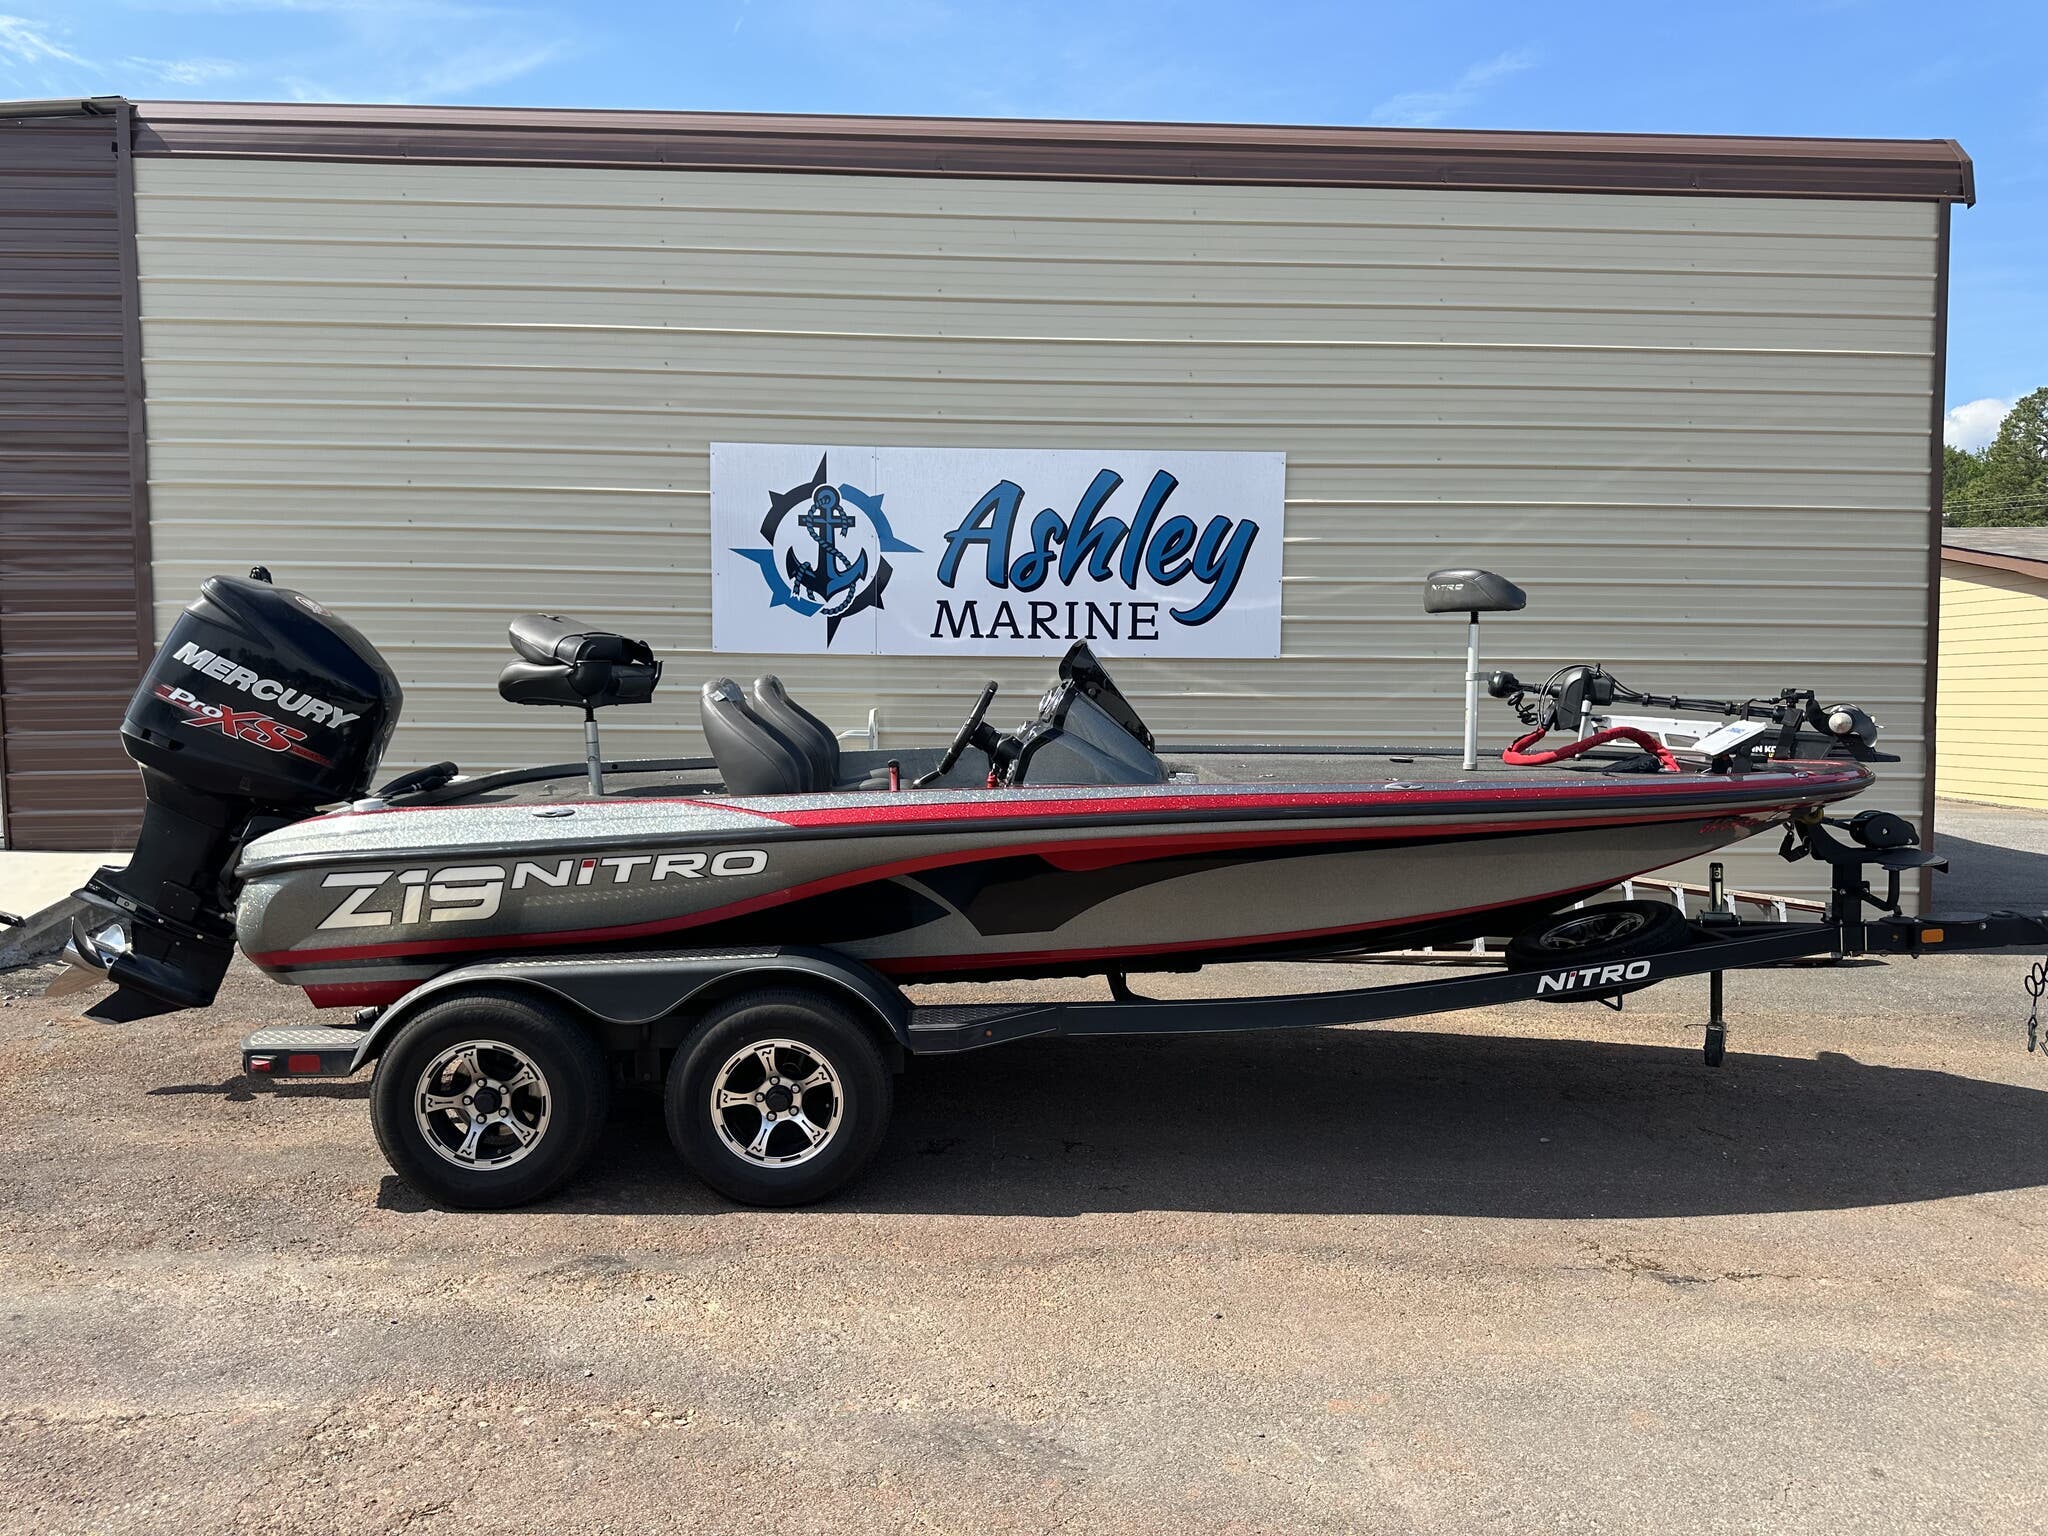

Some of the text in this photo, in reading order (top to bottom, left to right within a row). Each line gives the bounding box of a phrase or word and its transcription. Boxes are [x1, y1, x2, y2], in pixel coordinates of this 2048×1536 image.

[938, 469, 1260, 626] Ashley
[931, 600, 1160, 641] MARINE
[172, 641, 360, 729] MERCURY
[315, 865, 506, 930] Z19
